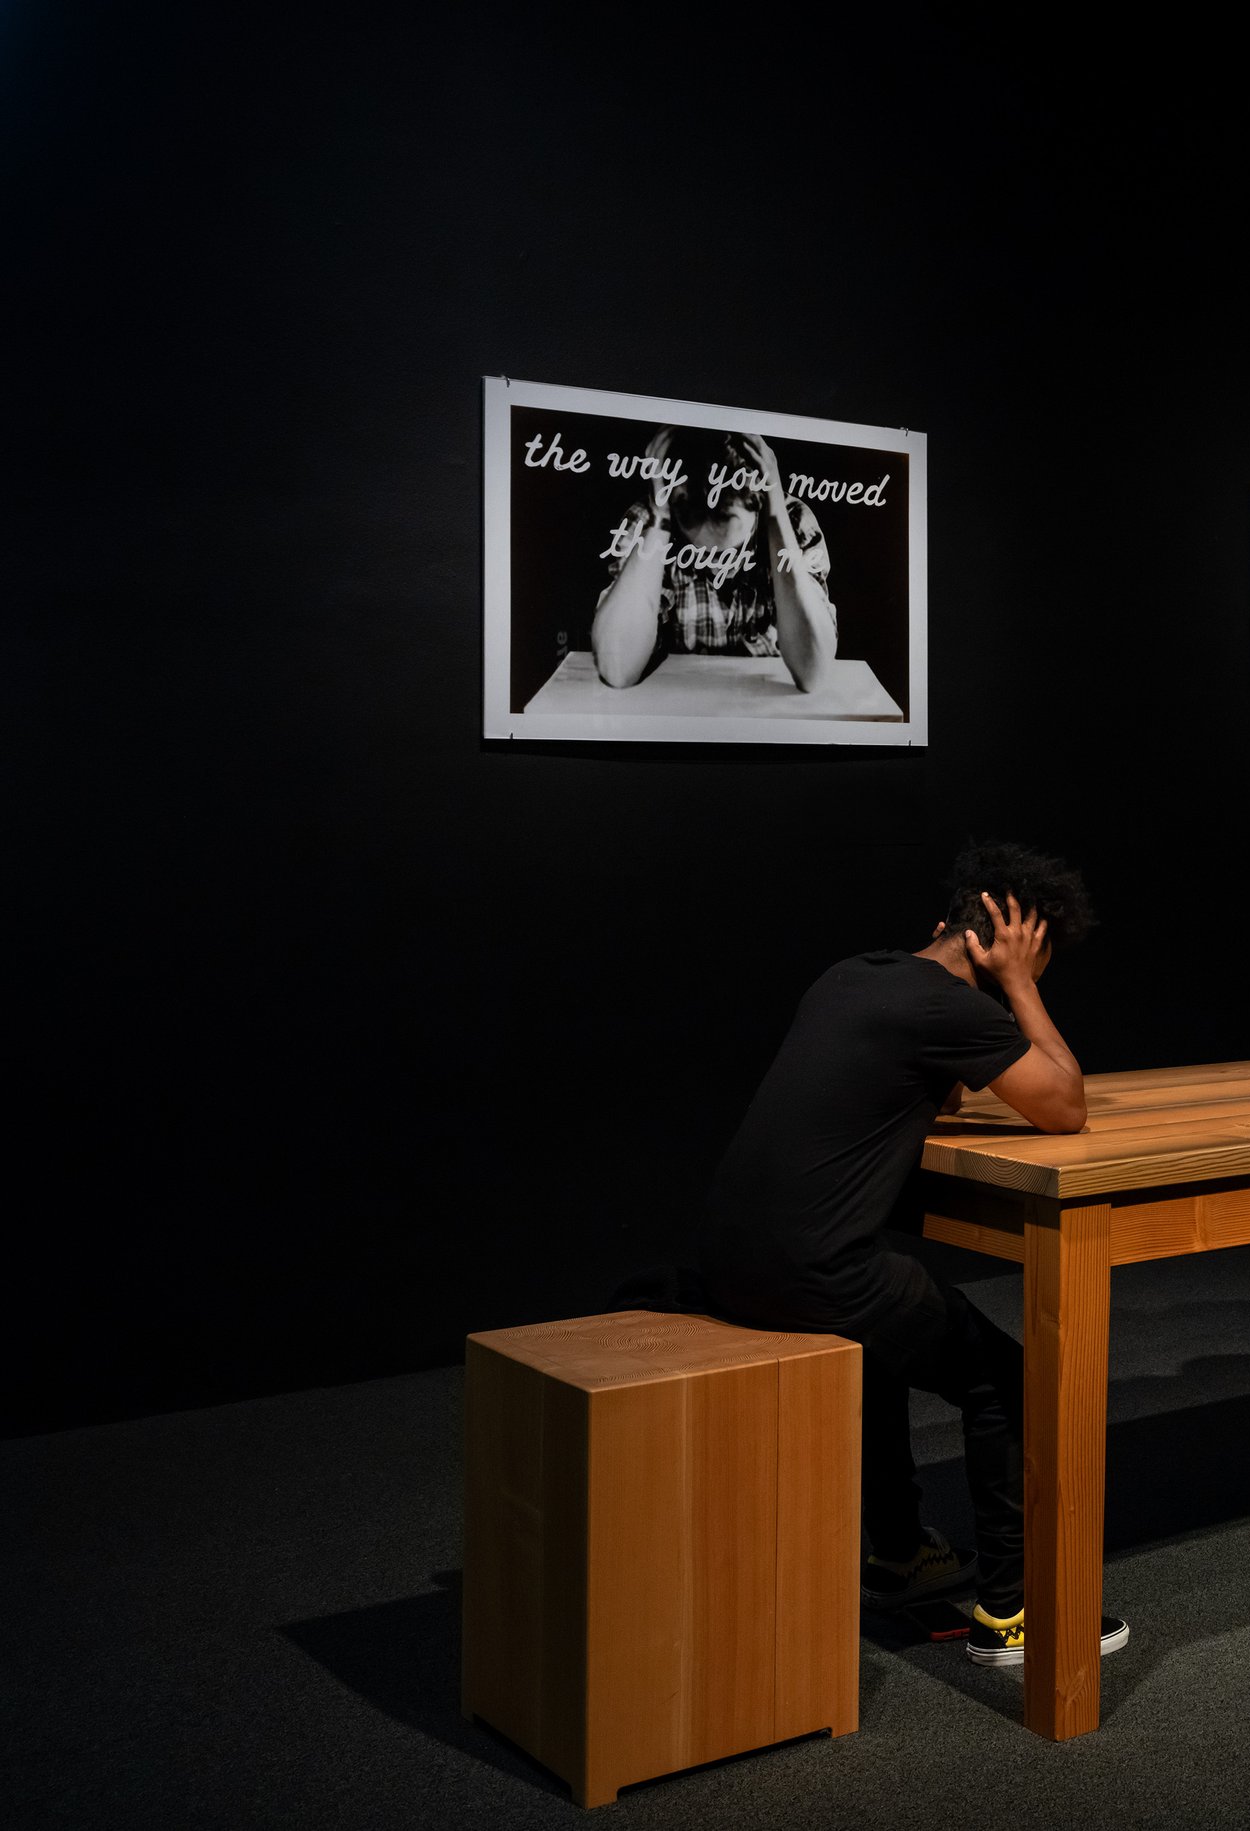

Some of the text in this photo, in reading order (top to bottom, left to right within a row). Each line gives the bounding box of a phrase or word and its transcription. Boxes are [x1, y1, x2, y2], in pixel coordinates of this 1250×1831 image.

[524, 433, 890, 507] the way you moved
